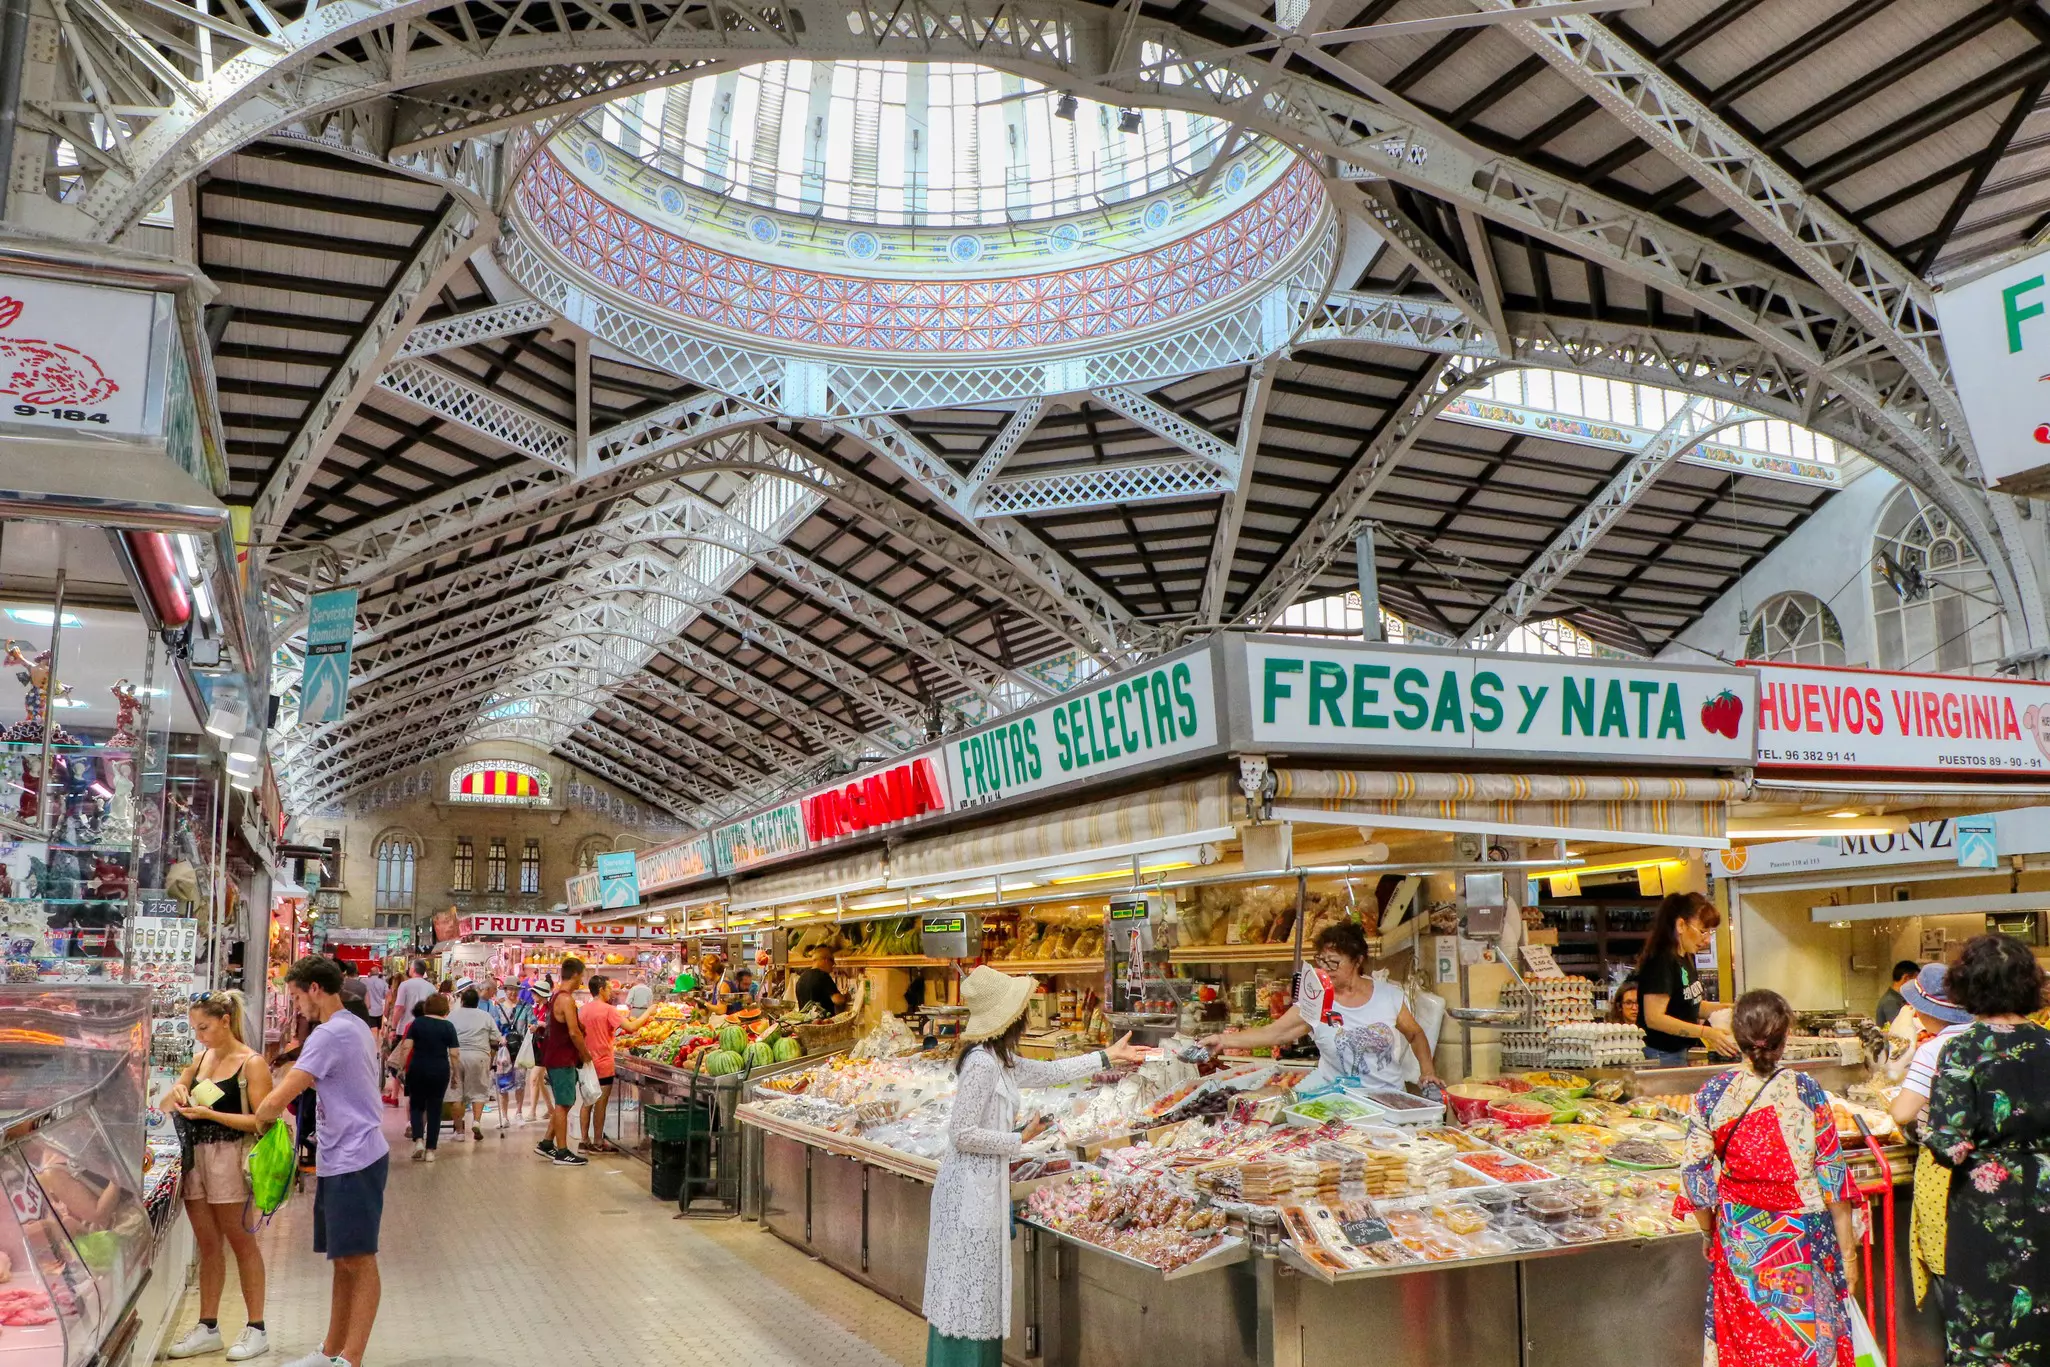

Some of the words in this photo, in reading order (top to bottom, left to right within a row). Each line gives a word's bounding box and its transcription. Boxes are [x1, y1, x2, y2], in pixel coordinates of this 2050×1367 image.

[13, 405, 110, 424] 9-184
[1263, 658, 1504, 734] FRESAS
[1561, 676, 1687, 740] NATA
[1759, 682, 1885, 736] HUEVOS
[1891, 689, 2022, 741] VIRGINIA
[959, 718, 1043, 797] FRUTAS
[1053, 662, 1198, 772] SELECTAS
[1757, 749, 1782, 760] TEL.
[1785, 750, 1799, 760] 96
[1803, 751, 1823, 761] 382
[1826, 752, 1839, 761] 91
[1843, 752, 1856, 762] 41
[1938, 755, 1986, 766] PUESTOS
[1988, 757, 2001, 766] 89
[2009, 757, 2022, 767] 90
[2030, 758, 2041, 768] 91
[716, 823, 749, 865] FRUTAS
[751, 803, 800, 857] SELECTAS
[474, 917, 565, 933] FRUTAS
